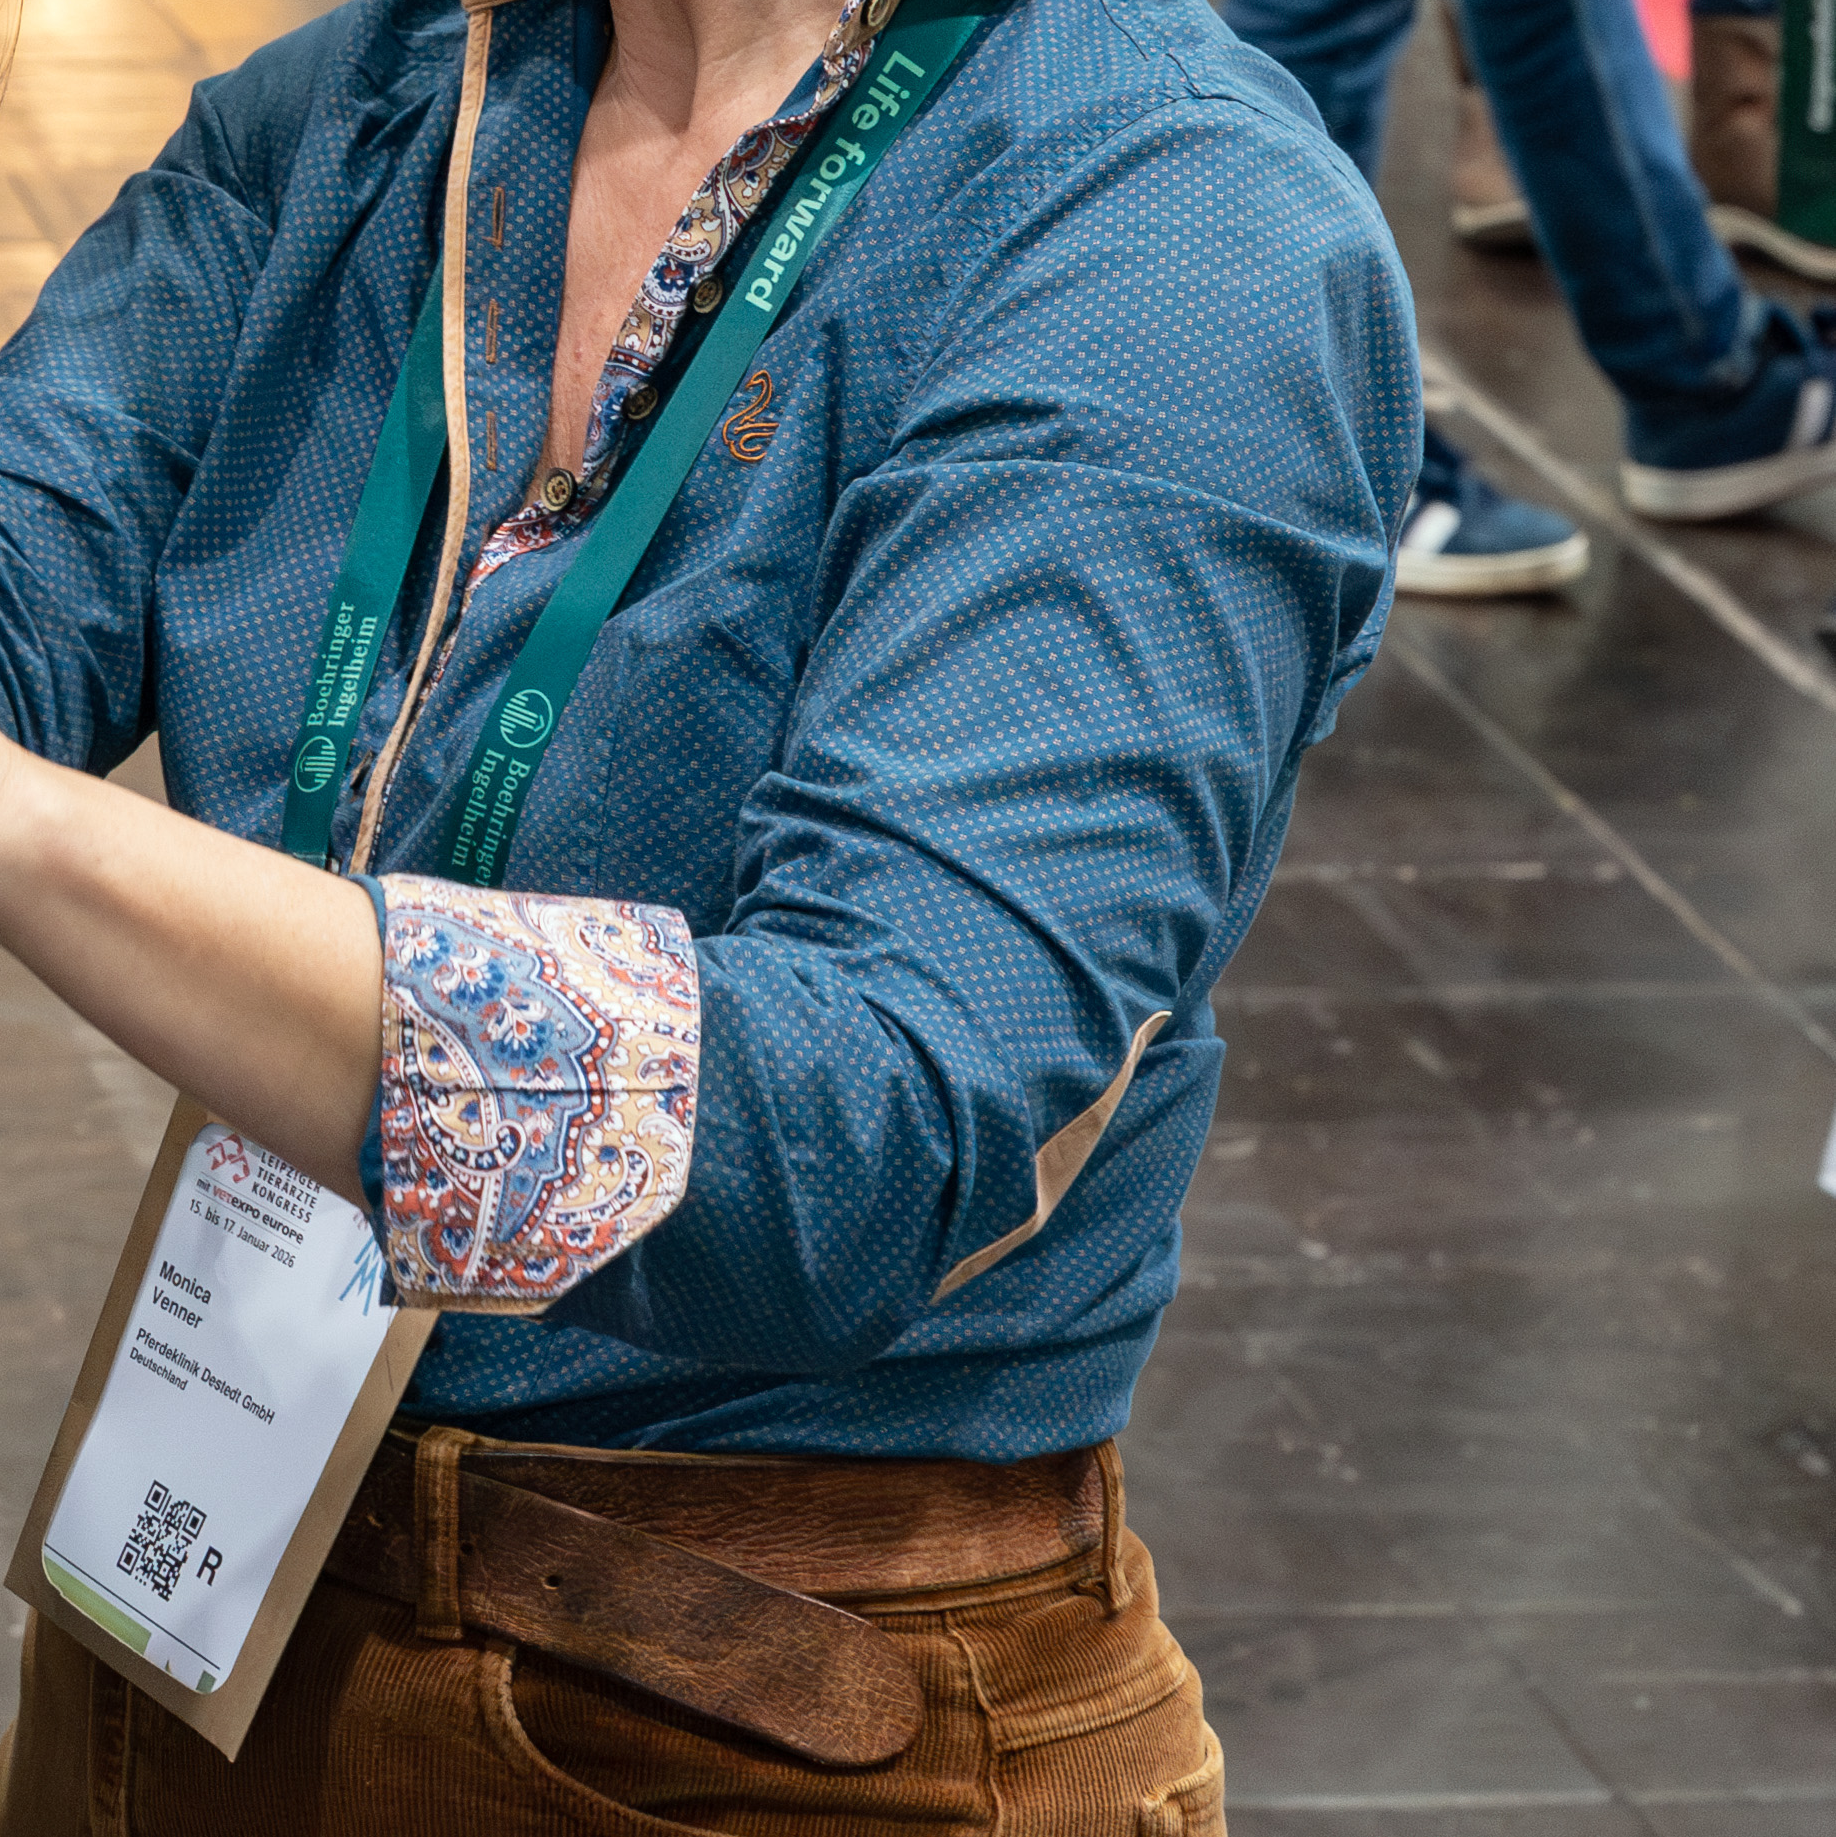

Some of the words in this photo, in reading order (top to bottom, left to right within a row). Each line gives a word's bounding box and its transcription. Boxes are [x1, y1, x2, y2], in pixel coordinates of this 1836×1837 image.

[851, 50, 926, 131] Life
[745, 137, 866, 312] forward
[307, 601, 355, 727] Boehringer
[327, 616, 377, 728] Ingelheim
[452, 748, 506, 867] Ingelheim
[196, 1177, 211, 1193] mit
[256, 1167, 318, 1209] TIERÄRZTE
[260, 1152, 322, 1194] LEIPZIGER
[251, 1181, 313, 1224] KONGRESS
[189, 1198, 203, 1217] 15.
[204, 1206, 220, 1226] bis
[224, 1218, 236, 1235] 17.
[236, 1226, 270, 1253] Januar
[270, 1245, 296, 1268] 2026
[158, 1260, 212, 1305] Monica
[152, 1285, 203, 1329] Venner
[129, 1346, 189, 1391] Deutschland
[135, 1327, 201, 1377] Pferdeklinik
[200, 1367, 242, 1404] Destedt
[241, 1394, 276, 1426] GmbH
[196, 1545, 223, 1587] R
